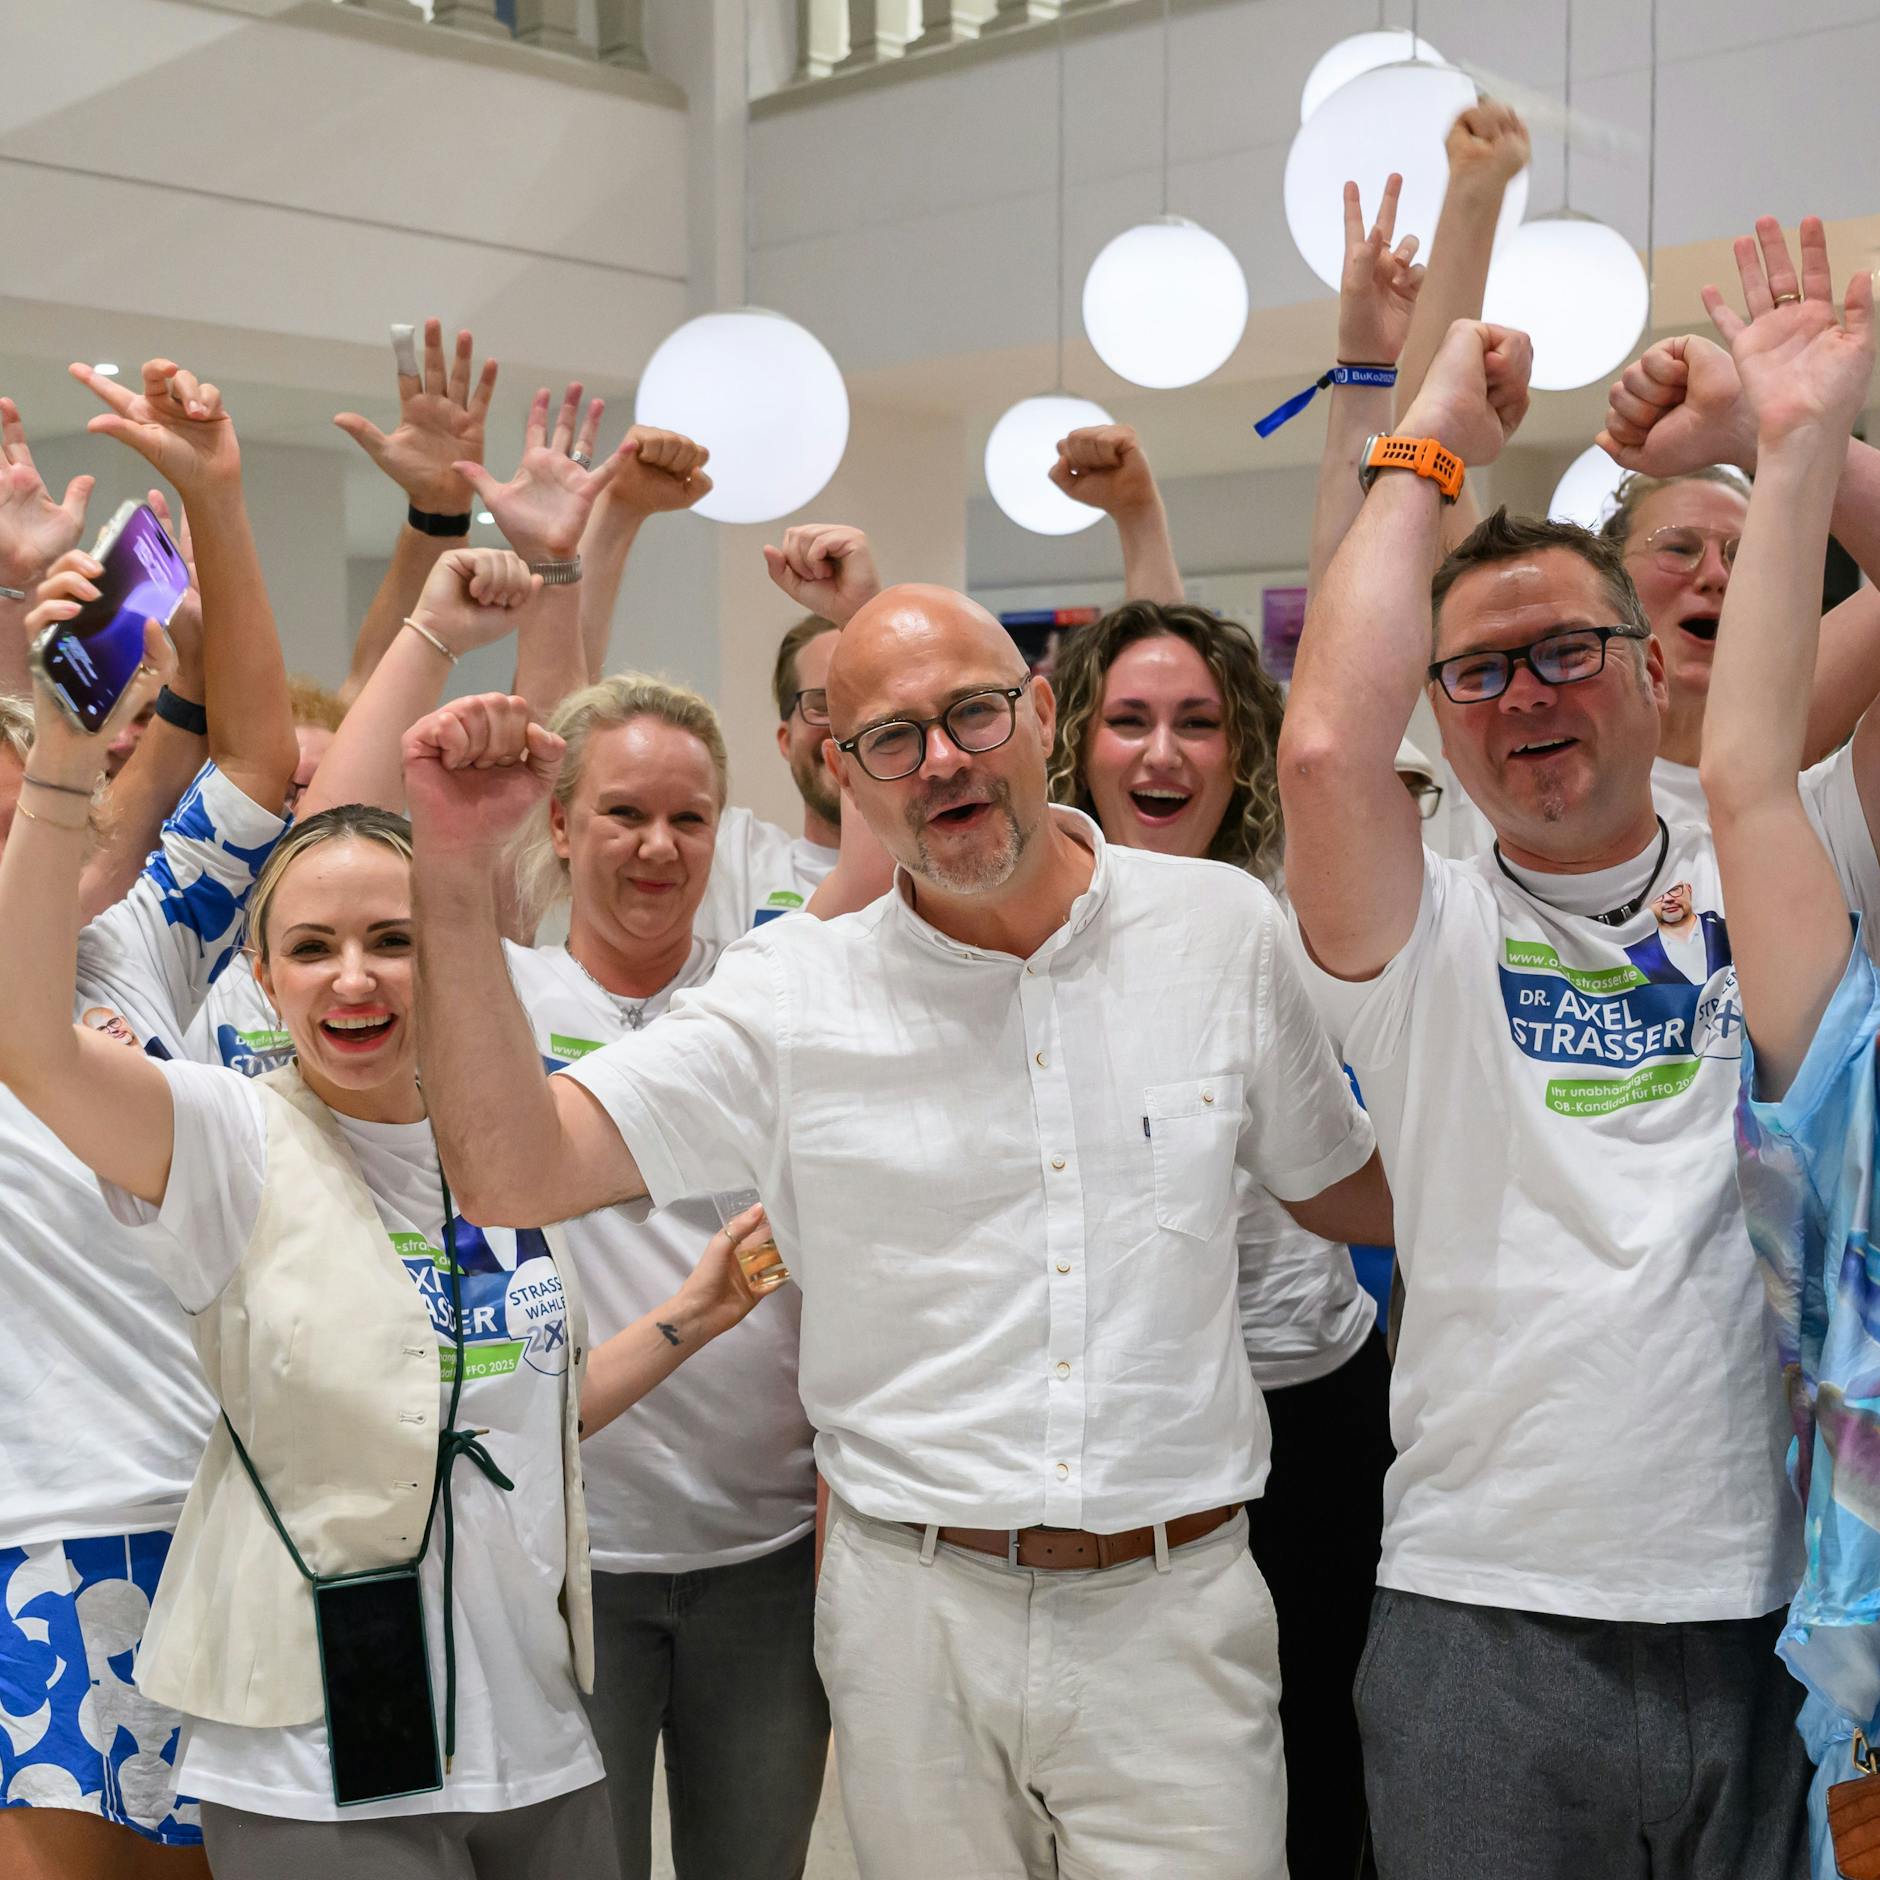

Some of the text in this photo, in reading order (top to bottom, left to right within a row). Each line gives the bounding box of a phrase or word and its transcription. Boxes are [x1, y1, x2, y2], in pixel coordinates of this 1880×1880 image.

[1519, 989, 1643, 1031] DR. AXEL
[1511, 1016, 1686, 1062] STRASSER
[1551, 1086, 1567, 1098] Ihr
[1553, 1093, 1630, 1113] OB-Kandidat
[1631, 1086, 1649, 1100] für
[1651, 1082, 1674, 1097] FFO
[509, 1276, 562, 1306] STRASS
[525, 1296, 566, 1320] WÄHLE
[465, 1363, 487, 1377] FFO
[488, 1358, 515, 1373] 2025
